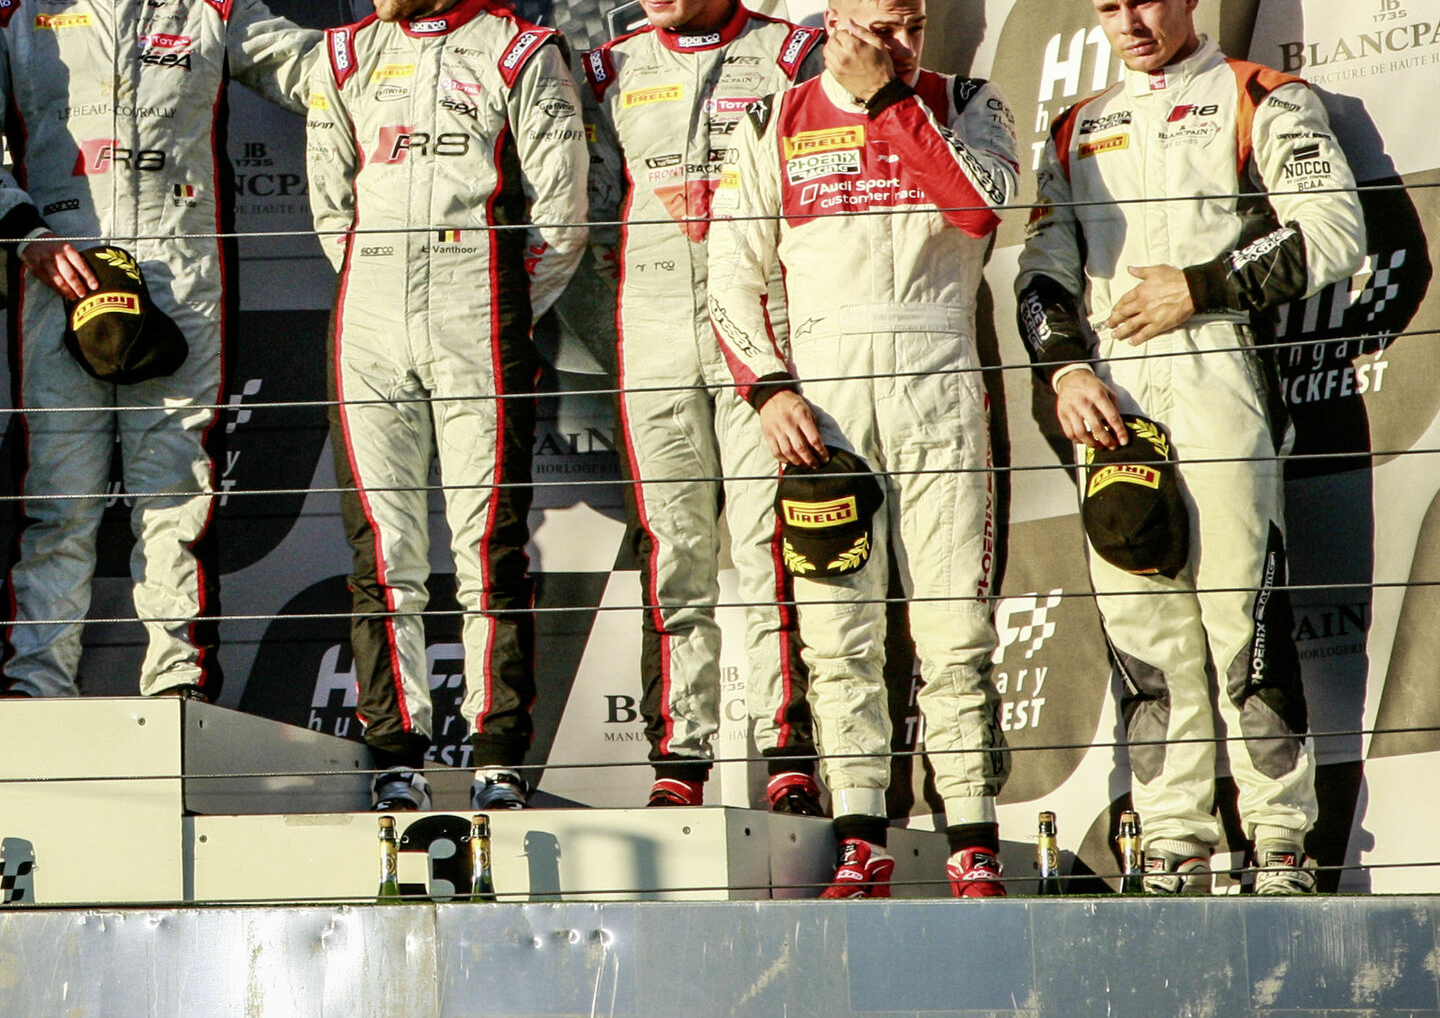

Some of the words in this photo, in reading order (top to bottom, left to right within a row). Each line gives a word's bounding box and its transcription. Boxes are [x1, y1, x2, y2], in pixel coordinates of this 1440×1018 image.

[1372, 10, 1407, 23] 1735
[503, 32, 537, 69] sparco
[678, 33, 720, 48] sparco
[782, 29, 810, 64] sparco
[1278, 20, 1440, 74] BLANCPA
[1370, 62, 1385, 74] DE
[1390, 53, 1427, 72] HAUTE
[626, 86, 679, 106] PIRELLI
[58, 104, 177, 121] LEBEAU-COURALLY
[390, 132, 470, 161] R8
[93, 146, 166, 171] R8
[234, 158, 274, 167] 1735
[1283, 160, 1331, 179] NOCCO
[820, 180, 852, 195] Audi
[855, 177, 900, 194] Sport
[821, 190, 890, 208] customer
[432, 245, 478, 255] Vanthoor
[73, 295, 136, 321] PIRELLI
[789, 504, 853, 524] PIRELLI
